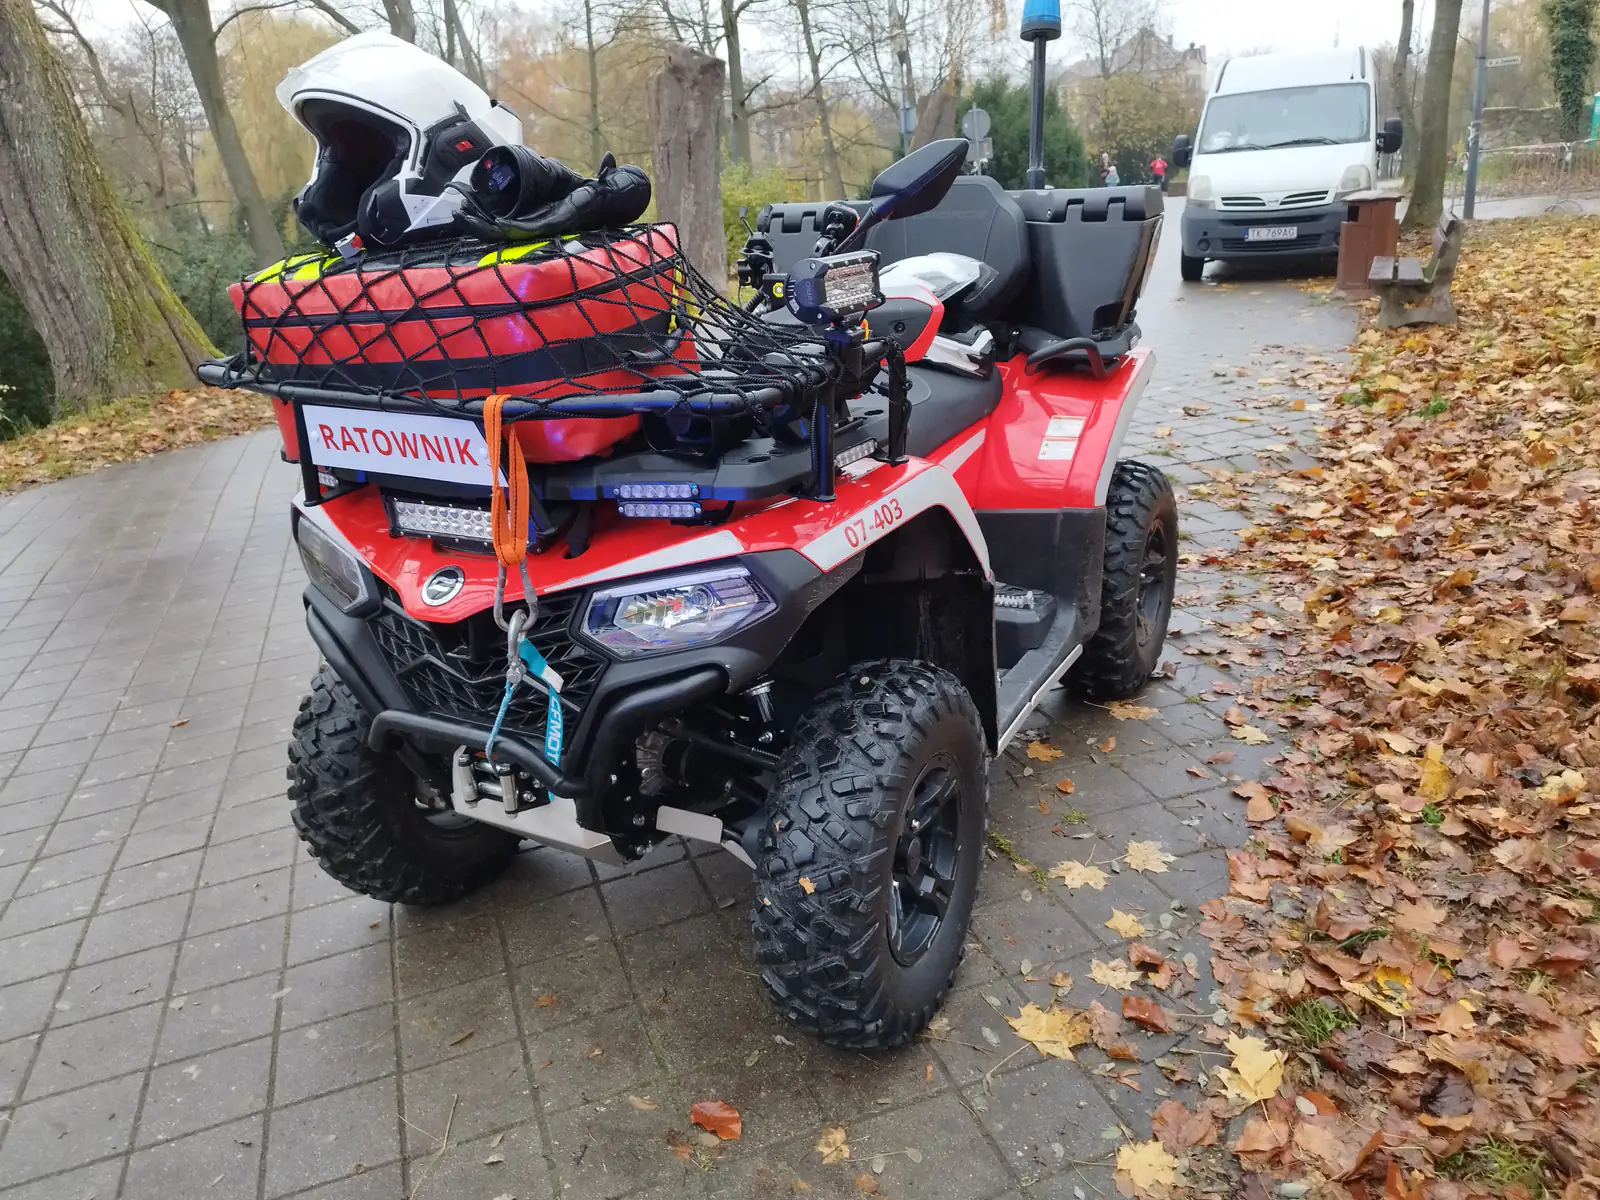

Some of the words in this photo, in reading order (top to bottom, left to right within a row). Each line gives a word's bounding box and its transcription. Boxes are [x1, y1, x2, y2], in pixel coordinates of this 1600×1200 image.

[318, 424, 479, 466] RATOWNIK
[844, 498, 903, 548] 07-403
[546, 695, 562, 767] CFMOT
